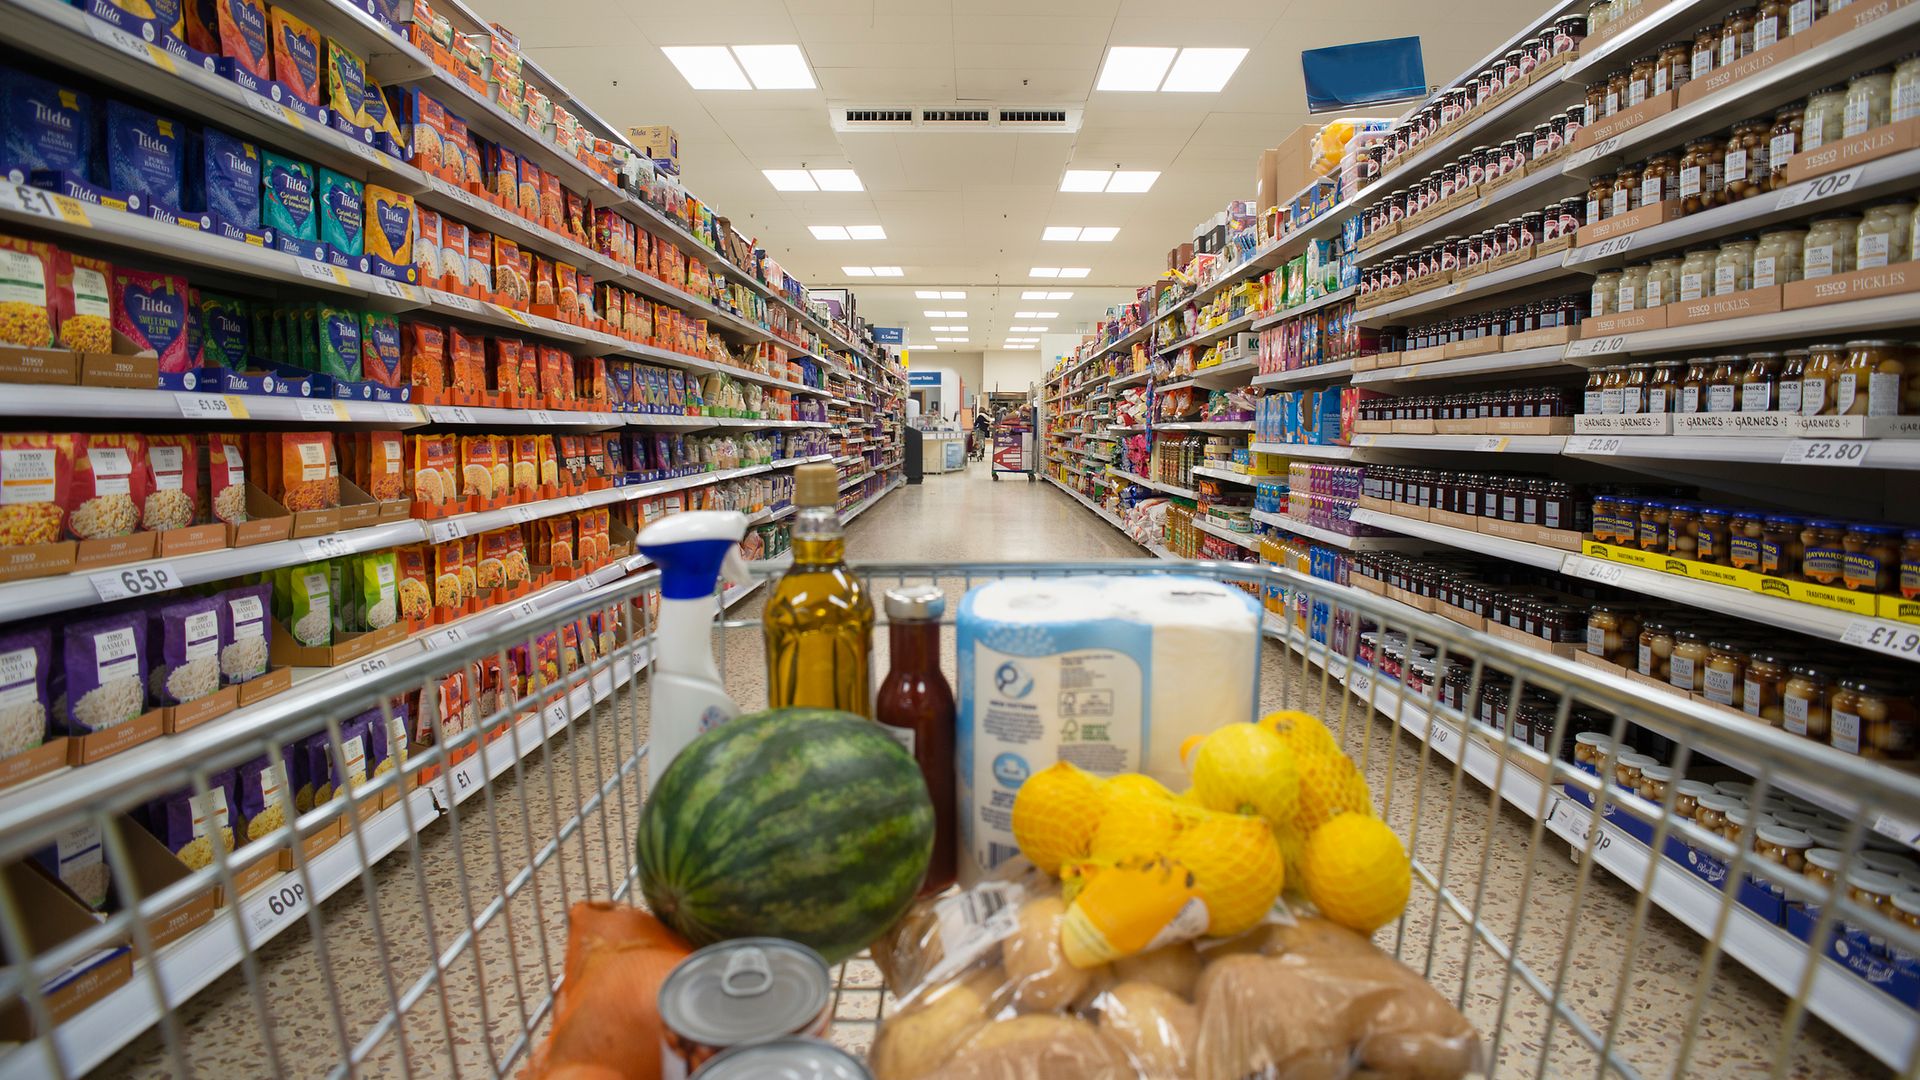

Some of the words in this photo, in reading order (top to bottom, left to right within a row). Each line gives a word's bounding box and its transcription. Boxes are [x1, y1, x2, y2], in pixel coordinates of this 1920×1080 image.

[93, 0, 121, 25] Tilda
[236, 2, 262, 29] Tilda
[1855, 2, 1888, 23] TESCO
[164, 35, 187, 58] Tilda
[288, 34, 312, 58] Tilda
[343, 62, 361, 83] Tilda
[1706, 72, 1730, 88] TESCO
[1734, 52, 1774, 79] PICKLES
[235, 68, 258, 91] Tilda
[27, 99, 72, 128] Tilda
[288, 95, 307, 114] Tilda
[337, 116, 354, 135] Tilda
[1615, 111, 1643, 130] PICKLES
[132, 128, 168, 153] Tilda
[1589, 139, 1616, 160] 70p
[1805, 150, 1837, 167] TESCO
[1843, 132, 1894, 158] PICKLES
[224, 152, 252, 175] Tilda
[64, 180, 99, 203] Tilda
[281, 173, 307, 193] Tilda
[1803, 174, 1851, 200] 70p
[16, 186, 55, 216] £1
[337, 191, 359, 210] Tilda
[150, 205, 177, 225] Tilda
[382, 206, 404, 224] Tilda
[1612, 215, 1639, 233] PICKLES
[221, 222, 244, 240] Tilda
[281, 237, 300, 254] Tilda
[1597, 236, 1630, 255] £1.10
[331, 251, 349, 266] Tilda
[378, 263, 396, 277] Tilda
[385, 282, 402, 296] £1
[1815, 281, 1846, 296] TESCO
[1852, 272, 1905, 291] PICKLES
[135, 294, 172, 314] Tilda
[1688, 304, 1710, 316] TESCO
[1714, 298, 1750, 313] PICKLES
[217, 316, 240, 332] Tilda
[336, 323, 356, 337] Tilda
[1597, 320, 1615, 330] TESCO
[1617, 316, 1645, 328] PICKLES
[376, 330, 394, 344] Tilda
[1591, 337, 1623, 352] £1.10
[227, 375, 248, 389] Tilda
[338, 384, 352, 395] Tilda
[376, 388, 391, 400] Tilda
[198, 400, 228, 411] £1.59
[1584, 419, 1611, 427] GARNER'S
[1620, 418, 1651, 429] GARNER'S
[1687, 417, 1723, 431] GARNER'S
[1736, 416, 1778, 430] GARNER'S
[1802, 419, 1840, 429] GARNER'S
[1588, 439, 1619, 451] £2.80
[1805, 443, 1863, 459] £2.80
[448, 522, 460, 537] £1
[121, 567, 168, 593] 65p
[1589, 564, 1621, 582] £1.90
[1700, 569, 1722, 578] TRADITIONAL
[1723, 573, 1736, 582] ONIONS
[1763, 582, 1788, 593] HAYWARDS
[1806, 590, 1836, 602] TRADITIONAL
[1837, 596, 1855, 605] ONIONS
[235, 603, 262, 615] BASMATI
[190, 621, 214, 632] BASMATI
[101, 639, 131, 652] BASMATI
[0, 661, 33, 675] ASMATI
[457, 769, 471, 789] £1
[268, 882, 305, 916] 60p
